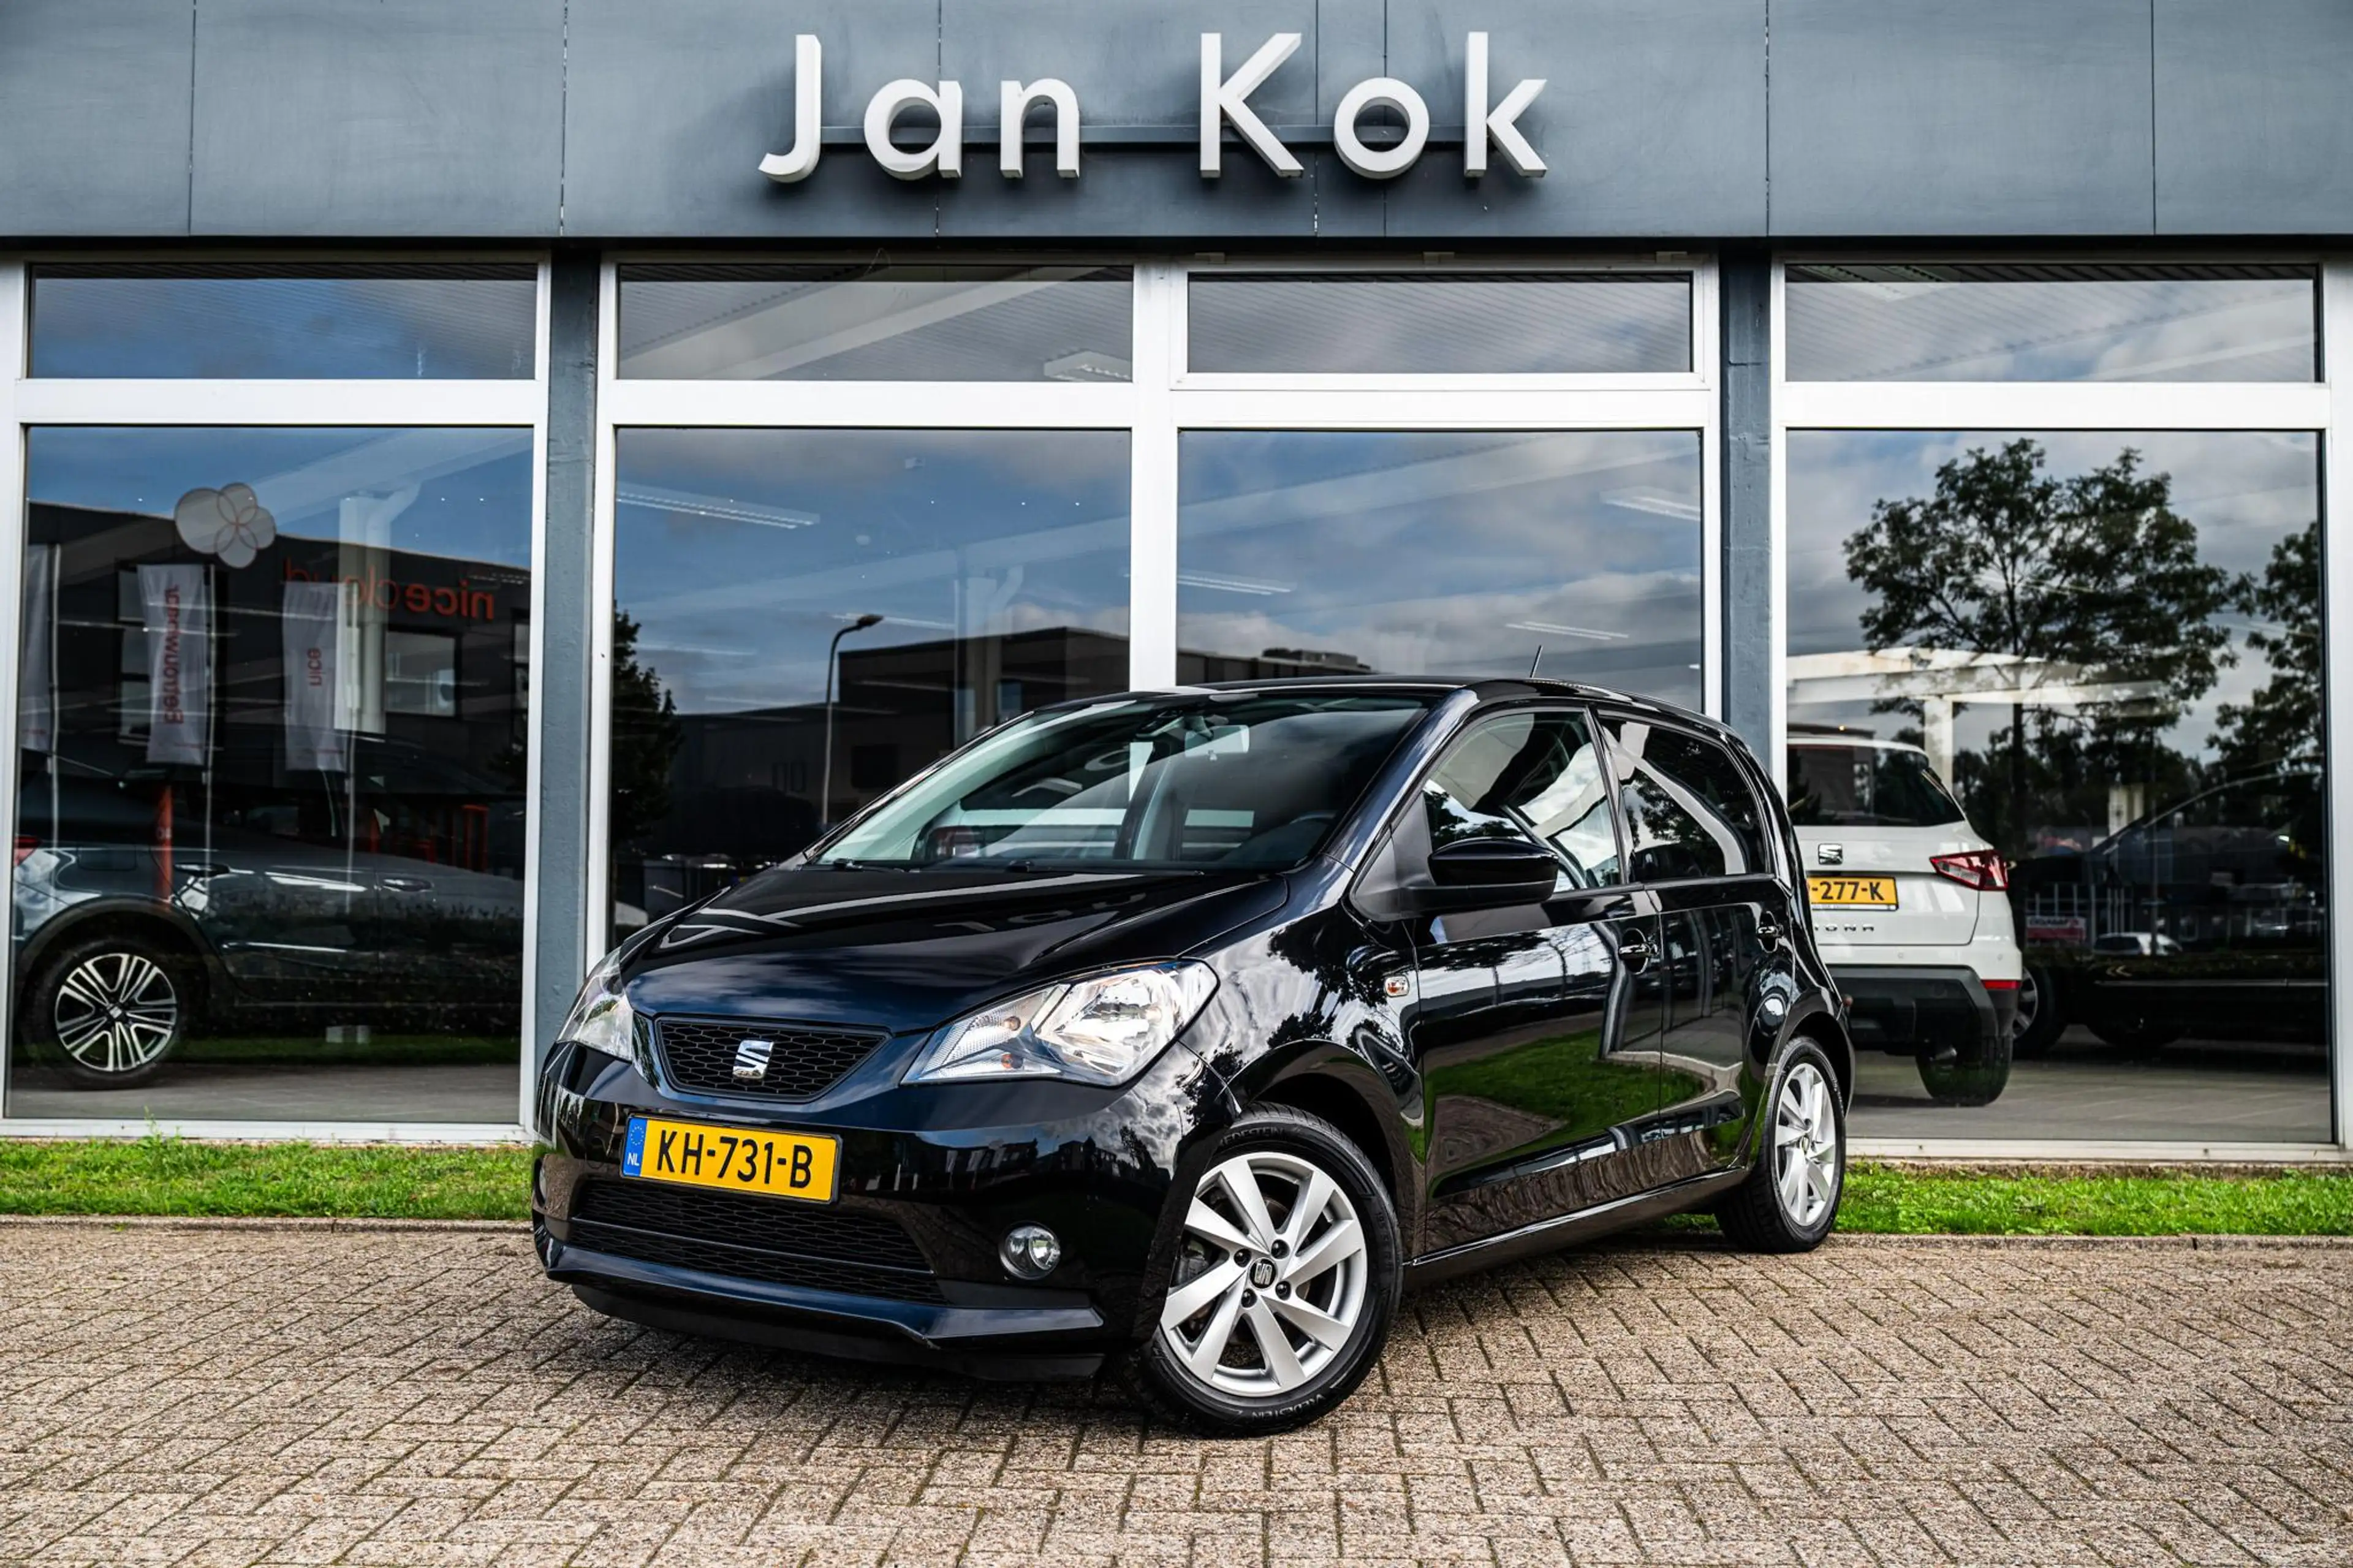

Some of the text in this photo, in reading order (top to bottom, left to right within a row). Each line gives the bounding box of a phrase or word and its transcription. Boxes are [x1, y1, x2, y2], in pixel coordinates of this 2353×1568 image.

[759, 31, 1548, 182] Jan Kok
[1808, 881, 1884, 901] -277-K
[627, 1152, 640, 1167] NL
[656, 1129, 814, 1189] KH-731-B
